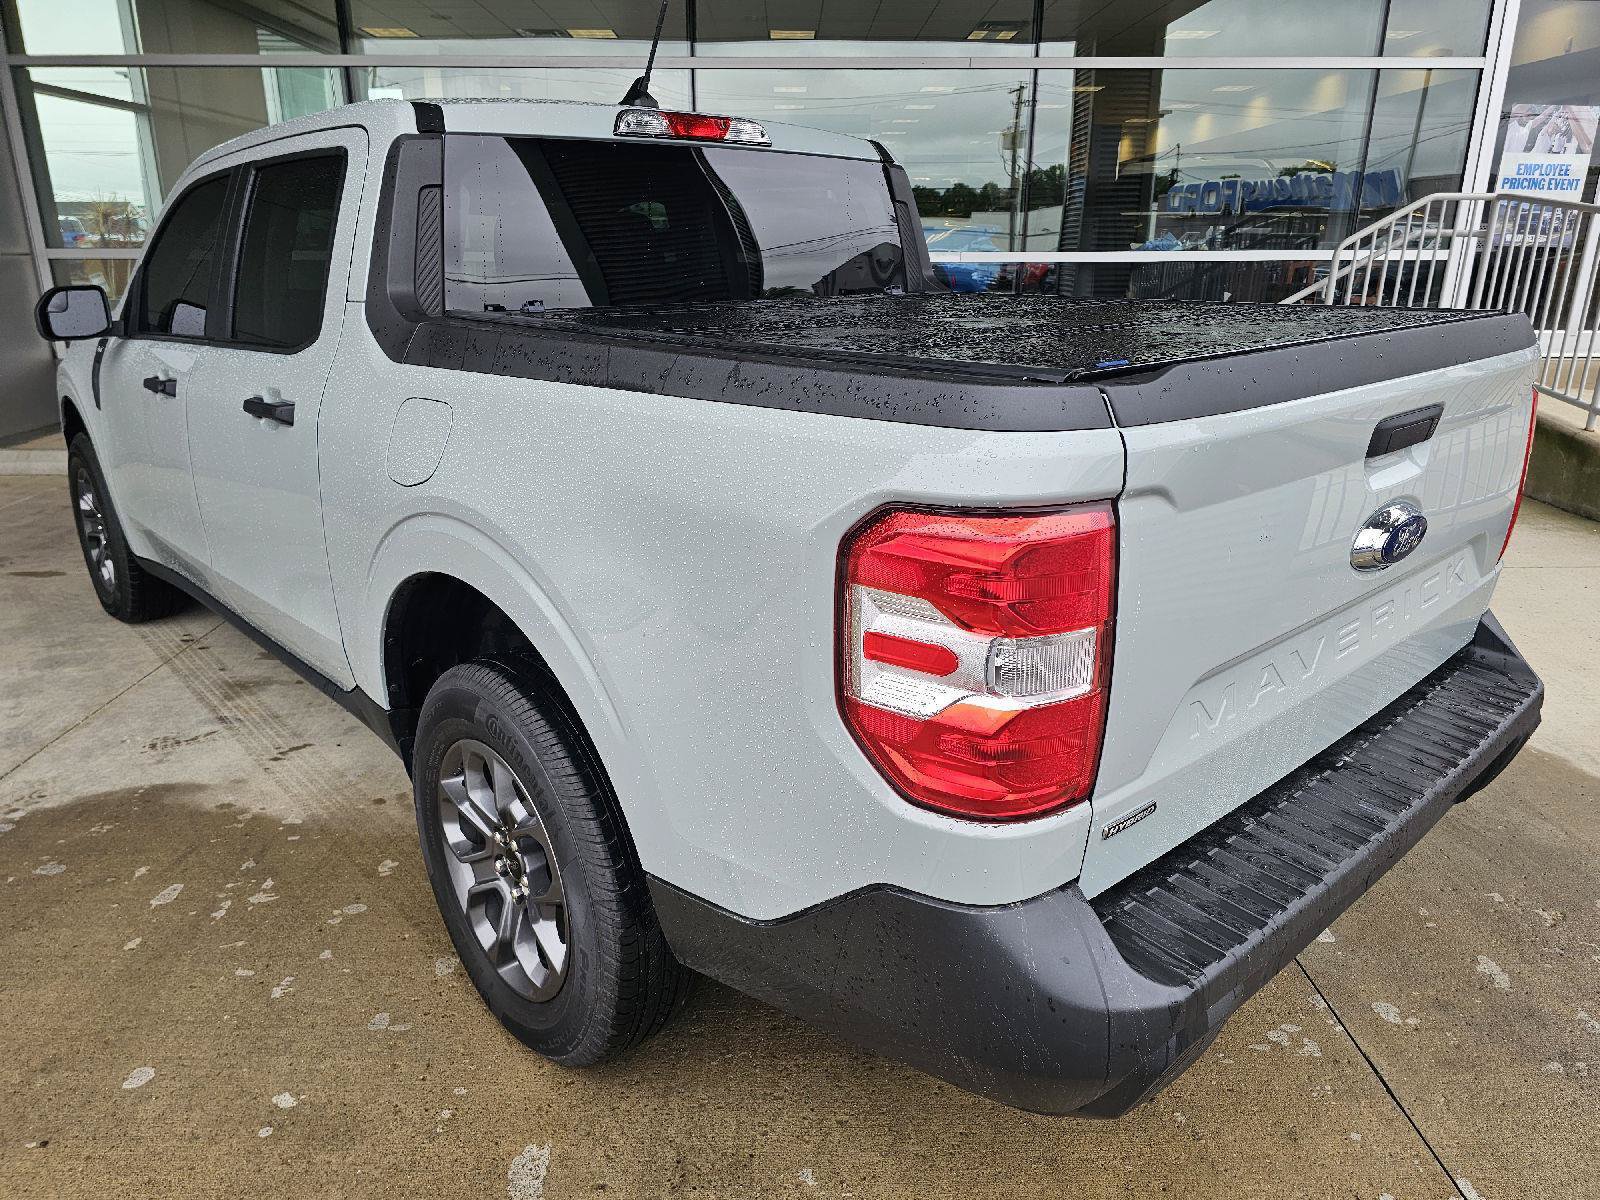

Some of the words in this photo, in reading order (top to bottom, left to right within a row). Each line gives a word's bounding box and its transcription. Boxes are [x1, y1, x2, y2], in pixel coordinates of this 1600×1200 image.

[1515, 163, 1572, 177] EMPLOYEE
[1501, 177, 1546, 191] PRICING
[1546, 178, 1581, 191] EVENT
[1189, 556, 1467, 740] MAVERICK
[1106, 804, 1155, 838] HYBRID
